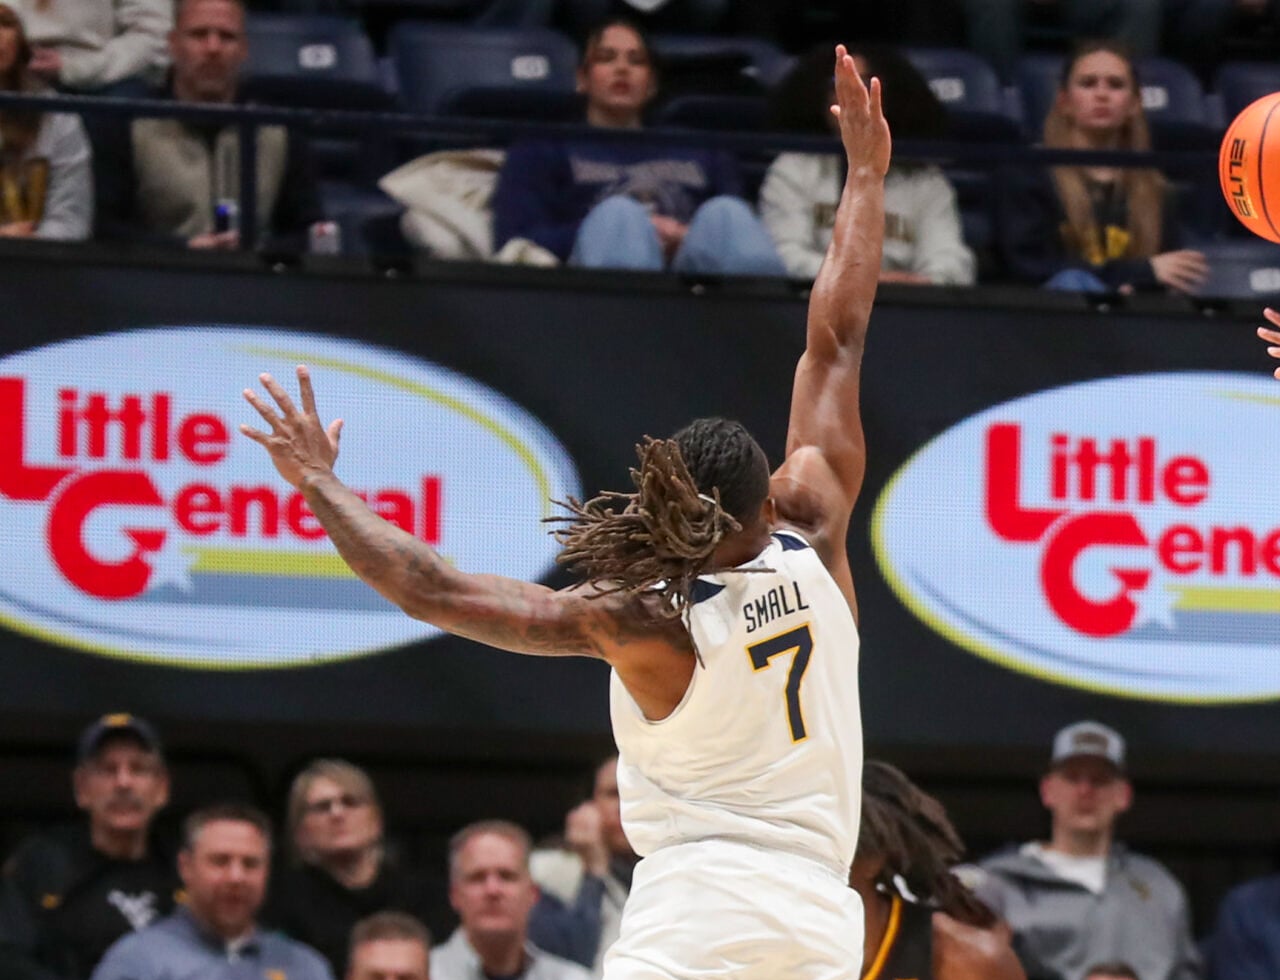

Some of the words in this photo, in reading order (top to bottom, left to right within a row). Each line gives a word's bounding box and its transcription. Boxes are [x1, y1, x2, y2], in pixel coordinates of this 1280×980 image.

[1229, 137, 1252, 218] ELITE
[47, 470, 443, 601] Geneal
[984, 422, 1211, 543] Little
[743, 581, 810, 633] SMALL
[744, 621, 814, 746] 7
